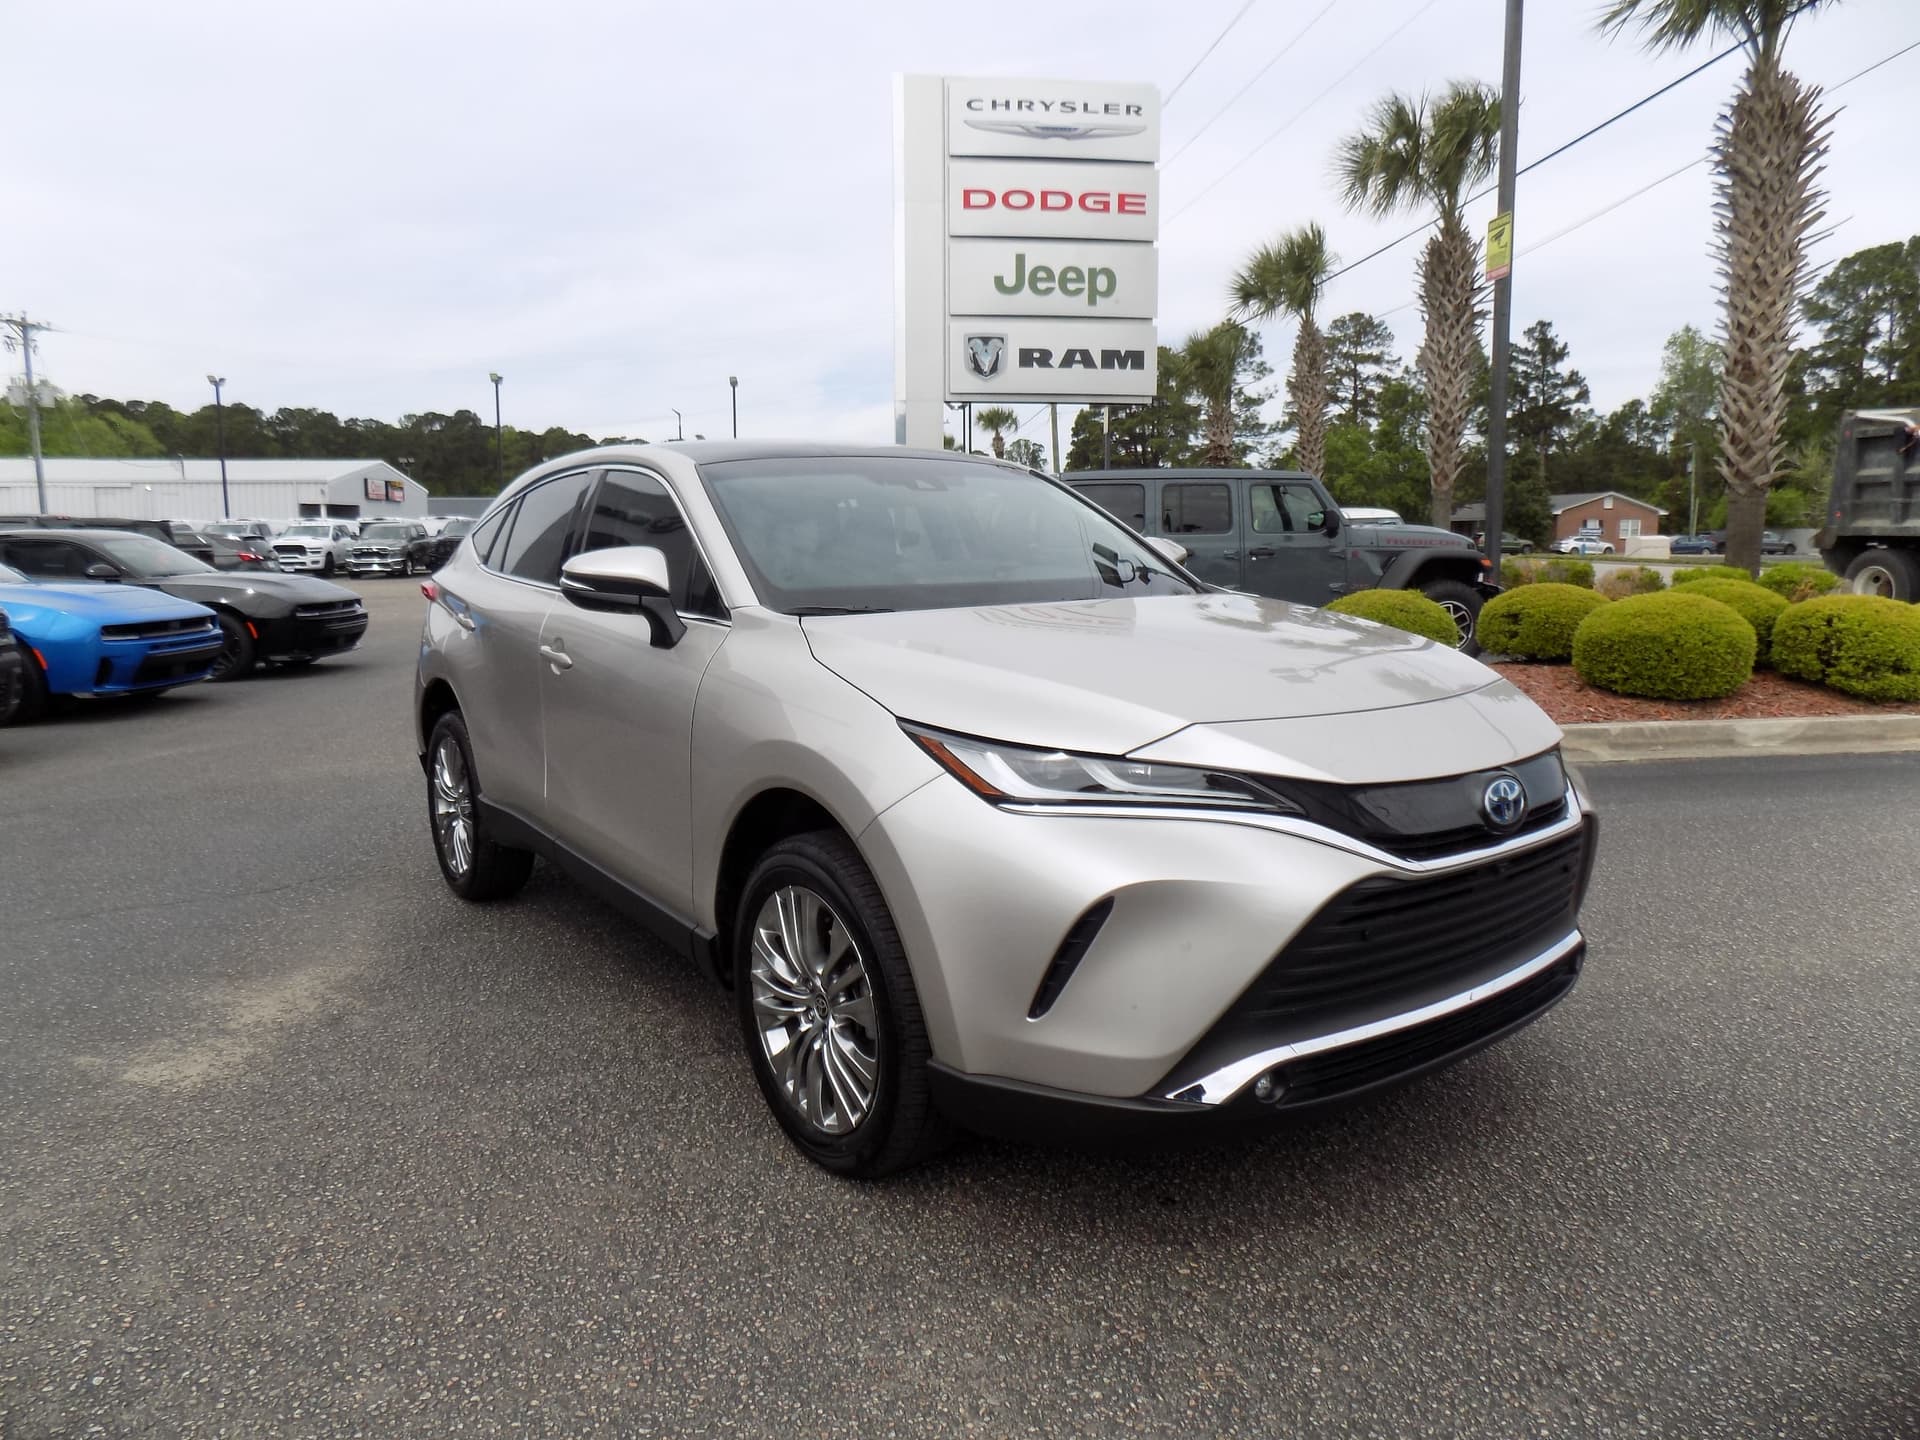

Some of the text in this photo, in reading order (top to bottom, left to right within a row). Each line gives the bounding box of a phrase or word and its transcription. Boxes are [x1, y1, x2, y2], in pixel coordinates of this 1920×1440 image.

[966, 99, 1143, 116] CHRYSLER
[963, 189, 1146, 214] DODGE
[994, 253, 1116, 306] Jeep
[1018, 348, 1145, 370] RAM
